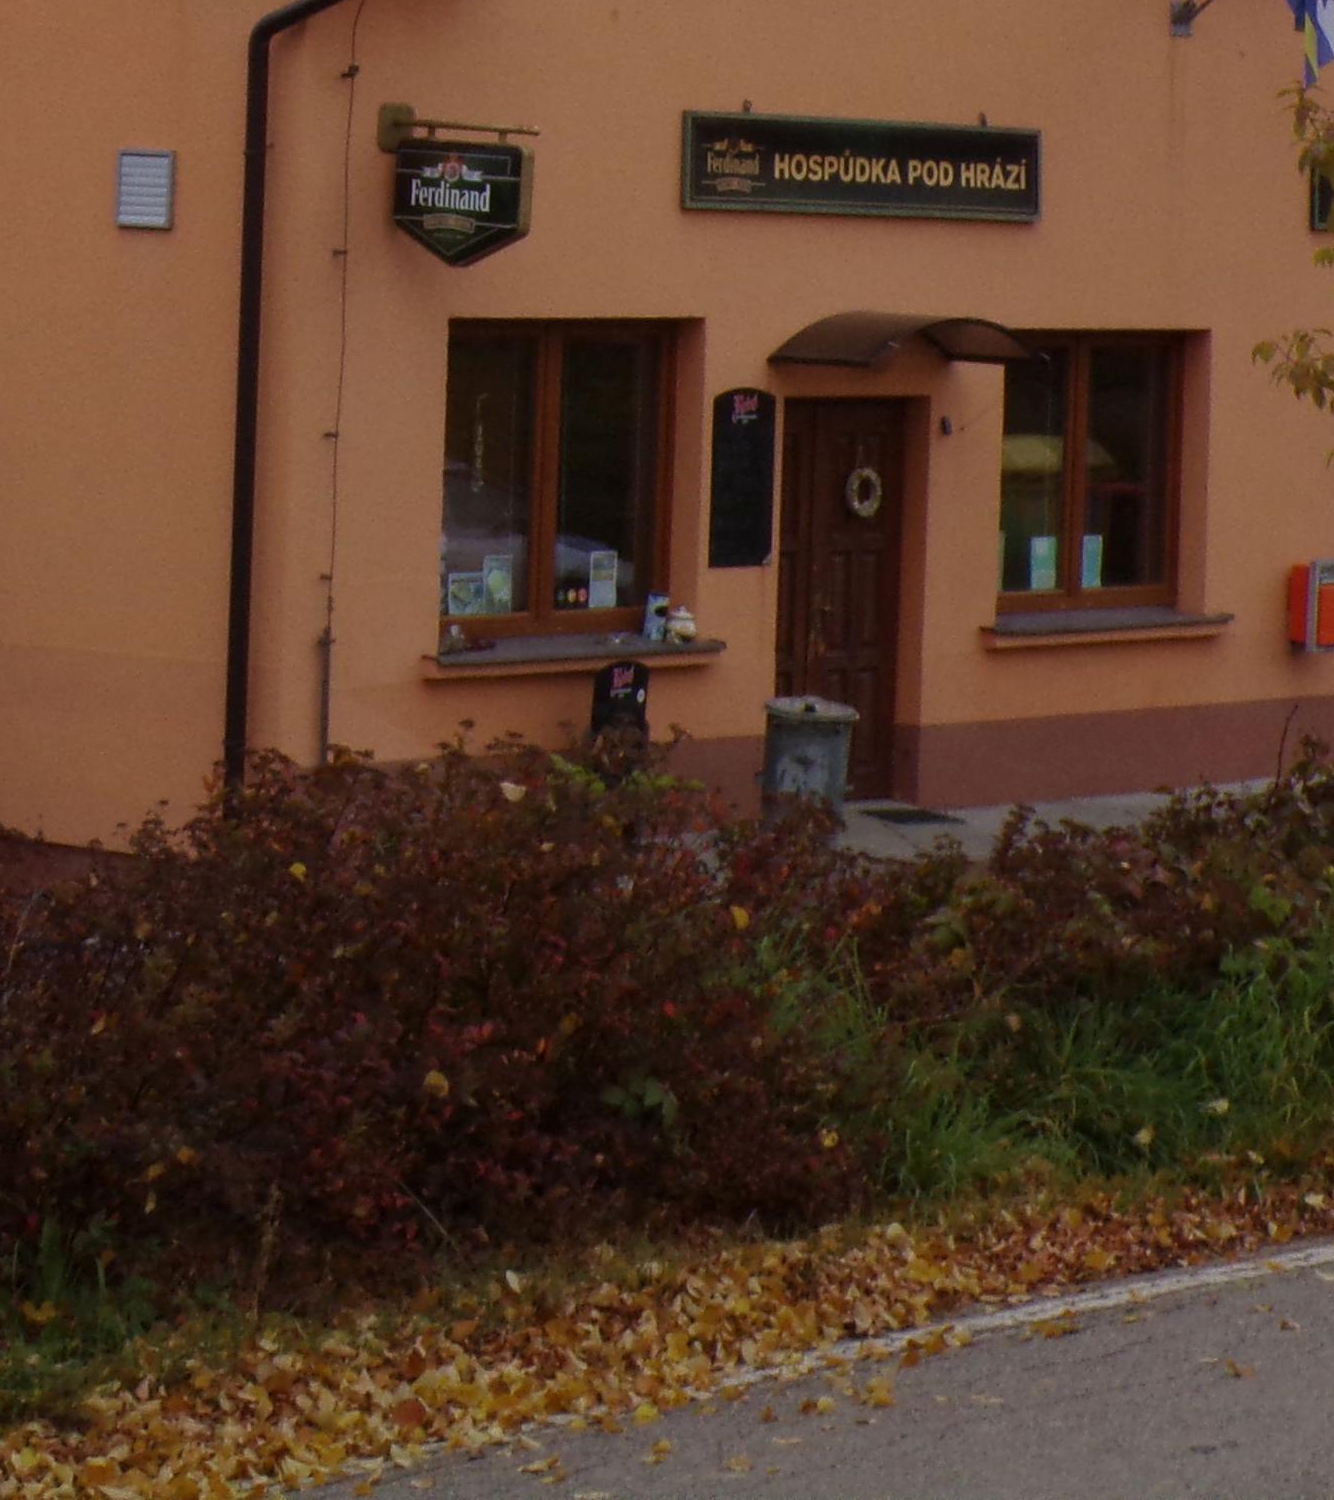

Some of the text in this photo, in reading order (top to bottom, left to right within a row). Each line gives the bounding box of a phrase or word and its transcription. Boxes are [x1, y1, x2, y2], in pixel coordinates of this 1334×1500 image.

[908, 159, 954, 186] POD
[960, 157, 1026, 190] HRÁZÍ
[410, 178, 490, 212] Ferdinand
